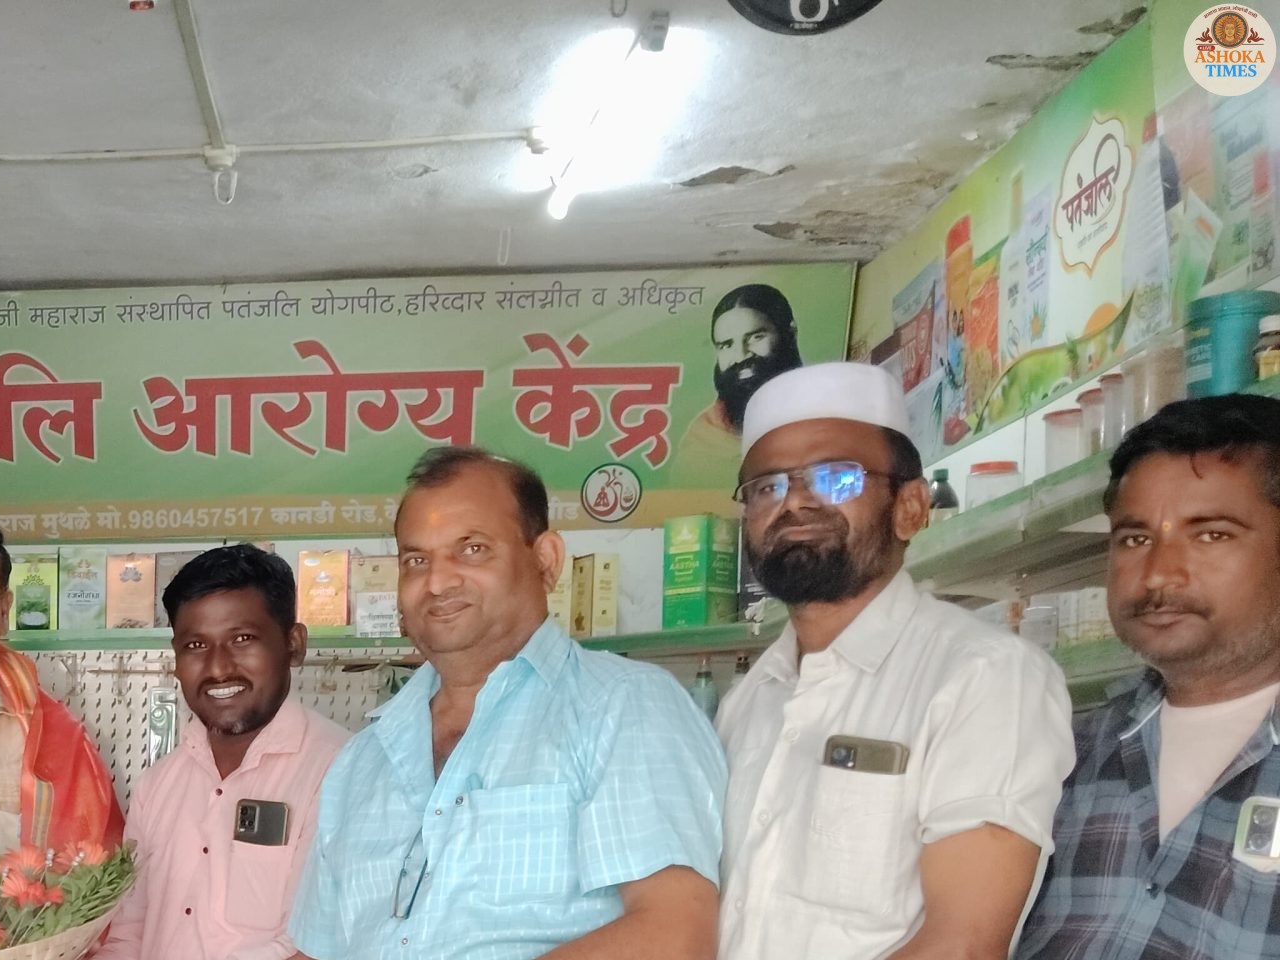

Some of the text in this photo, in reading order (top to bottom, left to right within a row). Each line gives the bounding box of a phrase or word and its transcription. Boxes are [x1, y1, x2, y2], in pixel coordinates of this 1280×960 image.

[28, 305, 106, 329] महाराज
[116, 294, 212, 324] संस्थापित
[222, 290, 302, 320] पतंजलि
[592, 288, 607, 307] व
[617, 278, 705, 314] अधिकृत
[132, 340, 484, 457] आरोग्य
[512, 333, 681, 471] केंद्र
